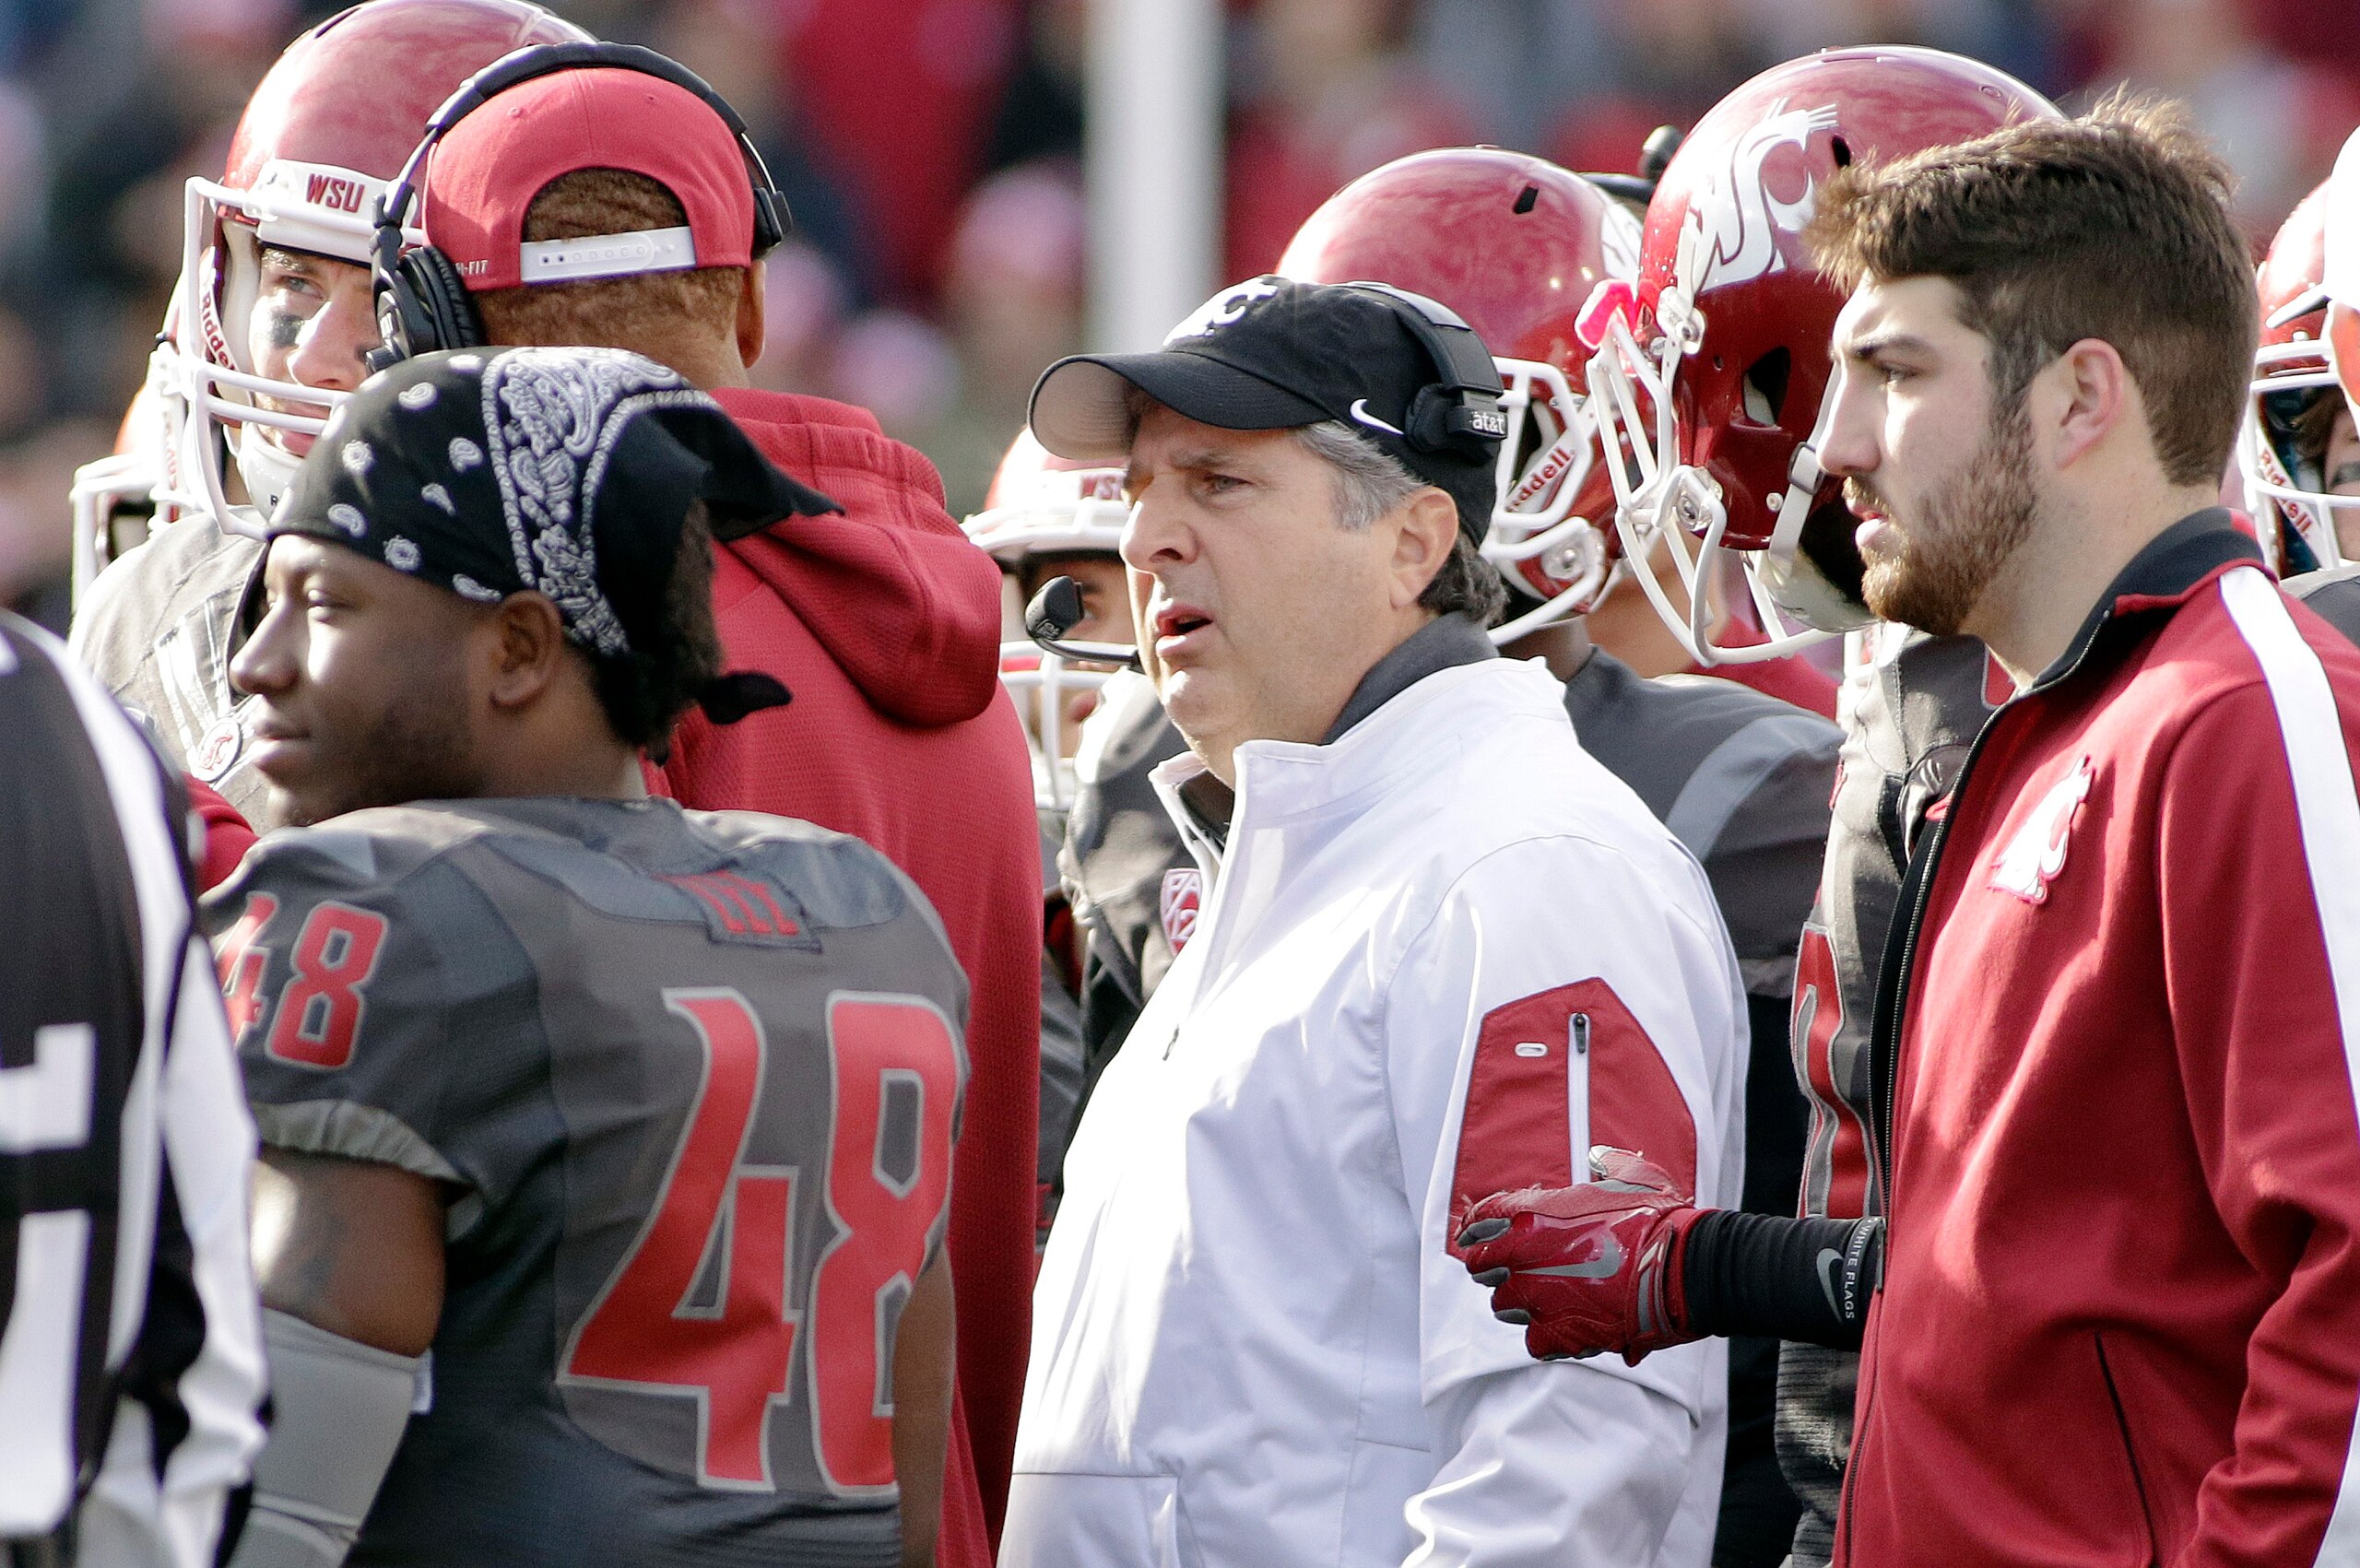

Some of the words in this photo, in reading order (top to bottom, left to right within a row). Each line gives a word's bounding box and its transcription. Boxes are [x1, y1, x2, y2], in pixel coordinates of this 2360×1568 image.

[306, 172, 365, 213] WSU
[1472, 411, 1506, 435] at&t
[2259, 448, 2312, 532] Ridell
[215, 890, 390, 1071] 48
[556, 985, 962, 1498] 48
[1847, 1224, 1872, 1267] WHITE
[1843, 1271, 1856, 1320] FLAGS
